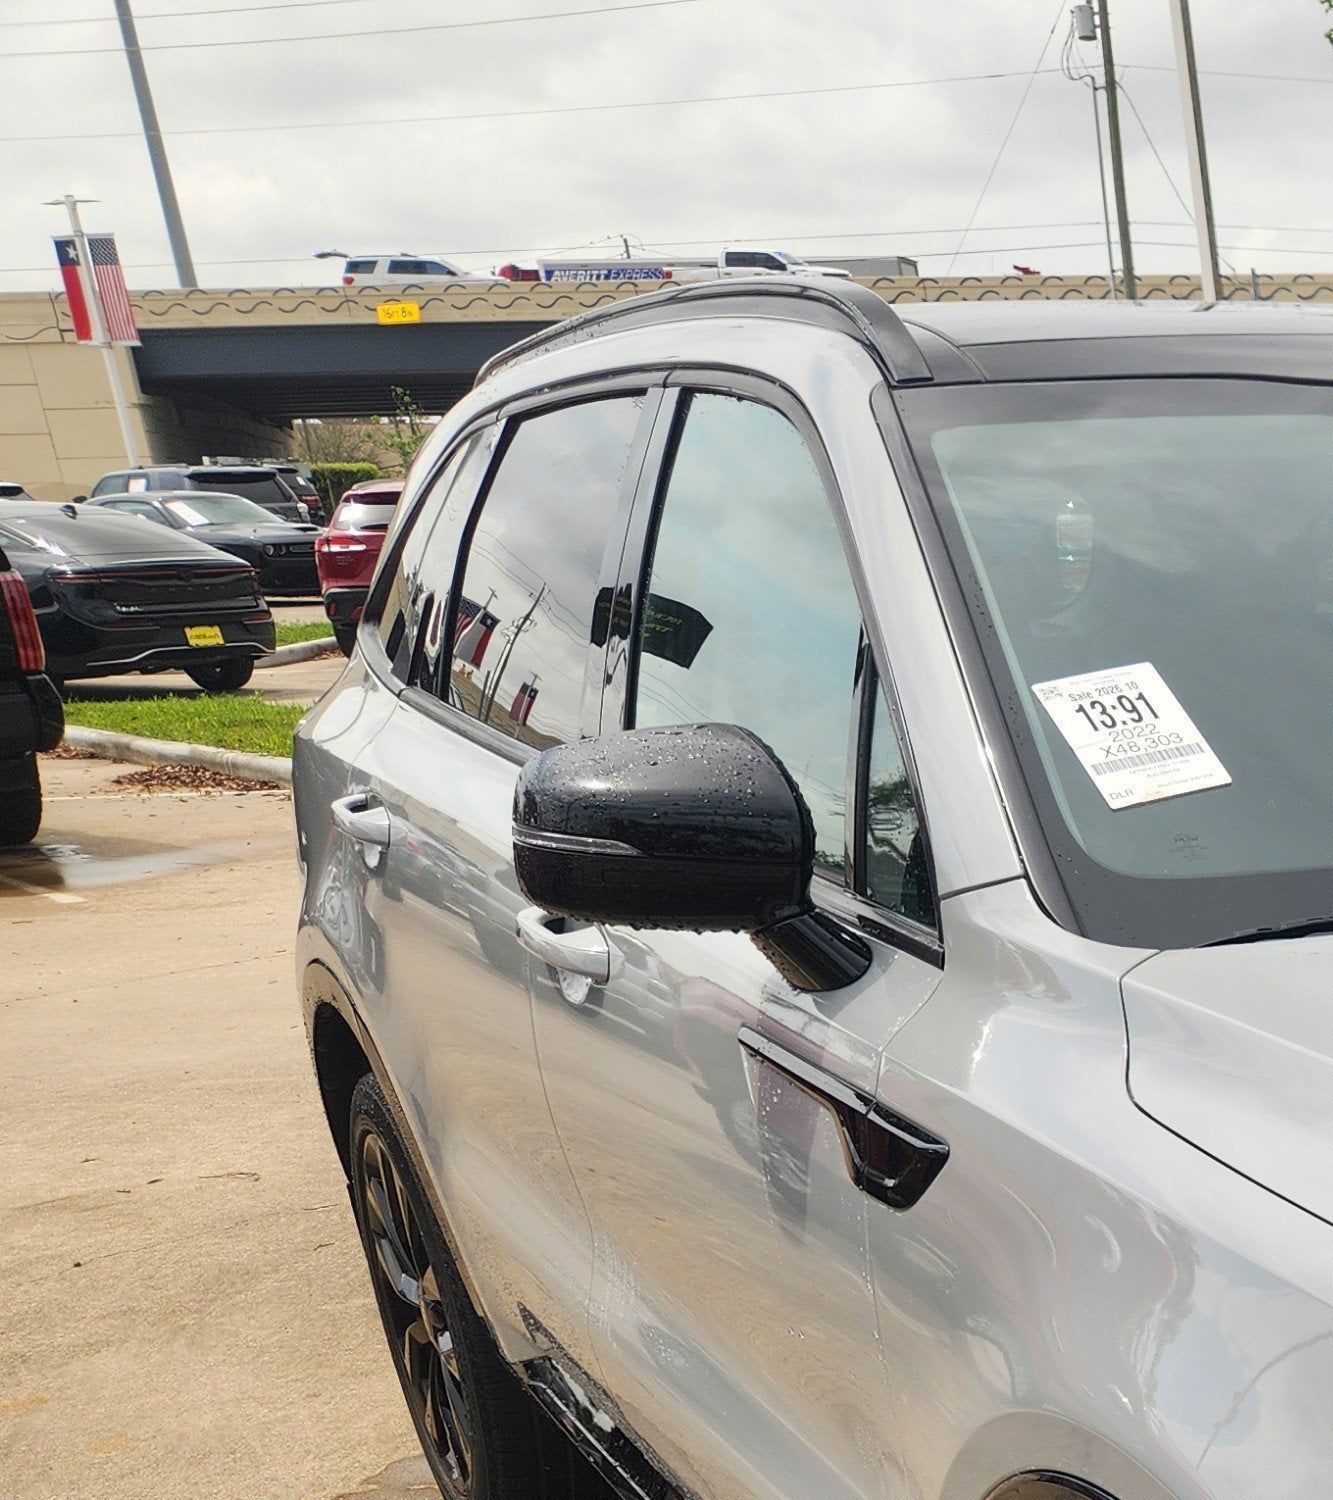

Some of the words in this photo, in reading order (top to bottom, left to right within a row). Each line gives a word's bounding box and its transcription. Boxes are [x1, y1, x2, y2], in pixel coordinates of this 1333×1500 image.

[551, 270, 609, 282] AVERITT
[1068, 691, 1093, 702] Sale
[1095, 684, 1122, 697] 2026
[1075, 692, 1159, 732] 13:91
[1109, 723, 1159, 742] 2022
[1099, 732, 1183, 759] X48,303
